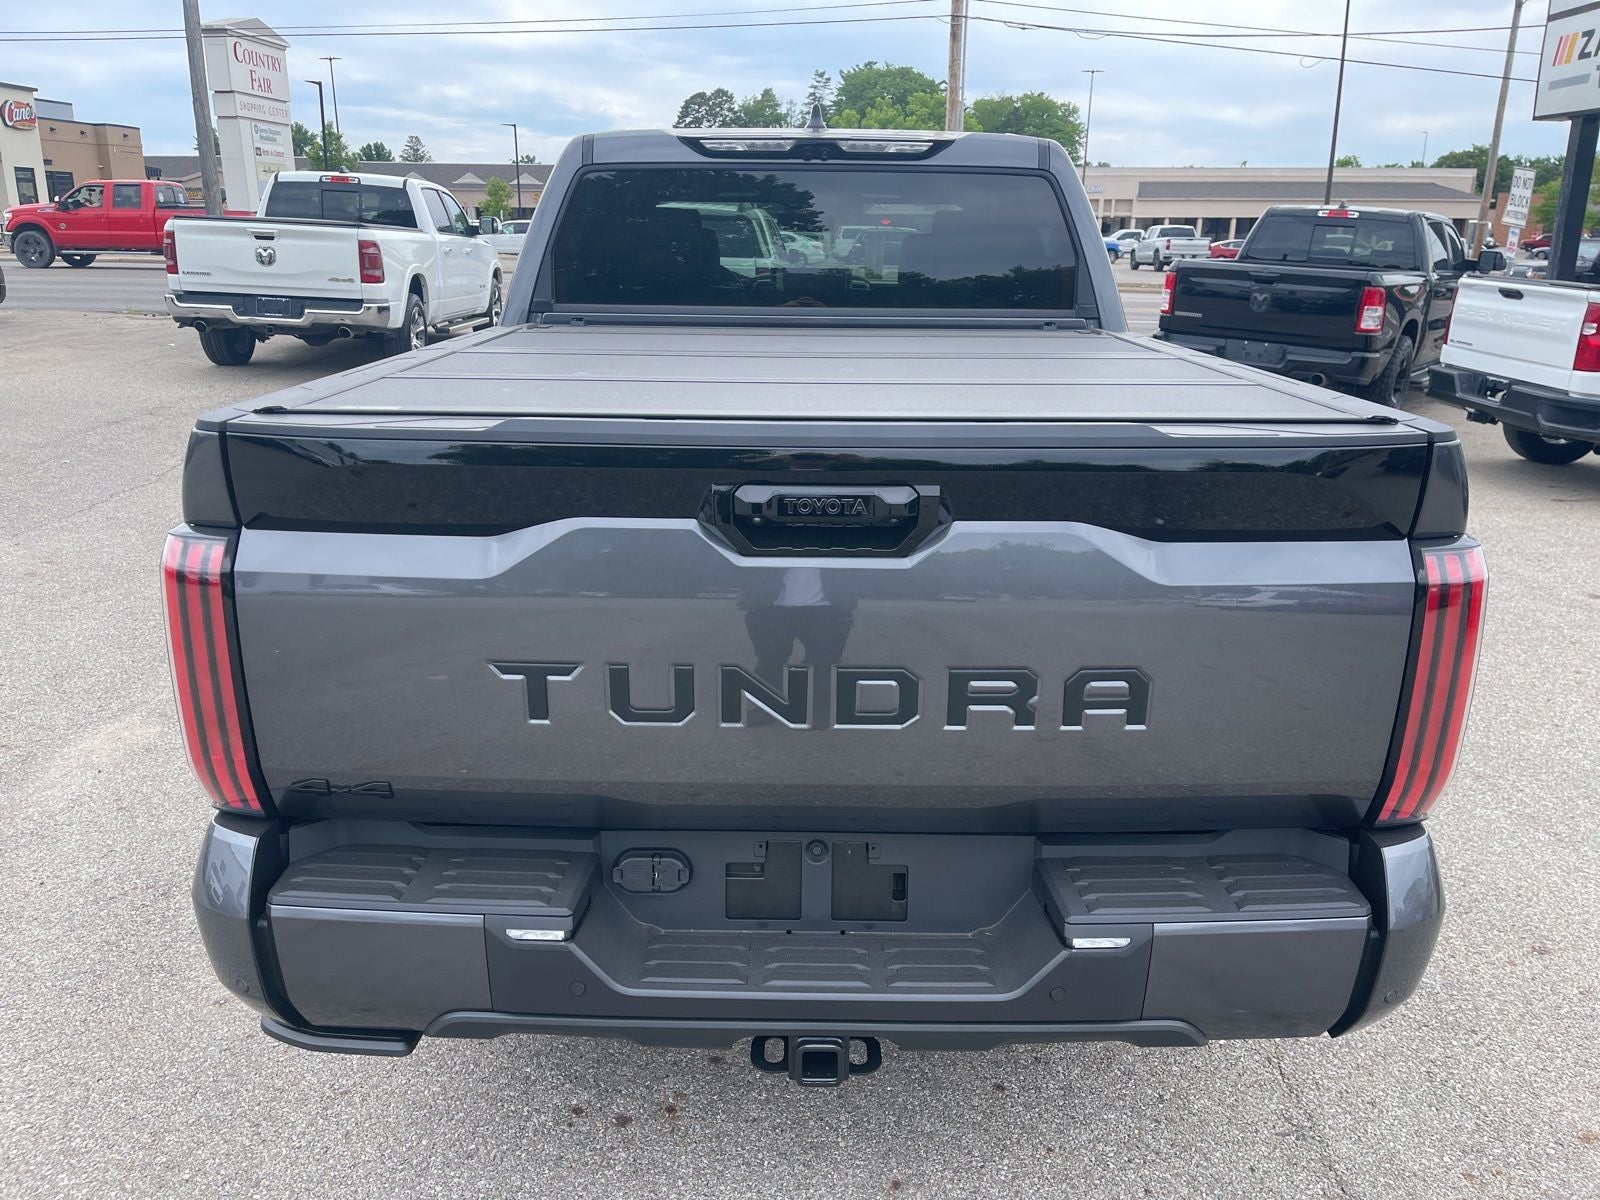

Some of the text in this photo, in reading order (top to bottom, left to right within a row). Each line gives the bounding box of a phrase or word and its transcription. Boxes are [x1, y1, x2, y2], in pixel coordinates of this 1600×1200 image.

[233, 41, 281, 72] COUNTRY
[249, 69, 273, 94] FAIR
[240, 100, 288, 118] SHOPPING CENTER
[1513, 175, 1534, 190] DO NOT
[1509, 193, 1530, 208] BLOCK
[784, 498, 868, 515] TOYOTA
[486, 660, 1153, 731] TUNDRA
